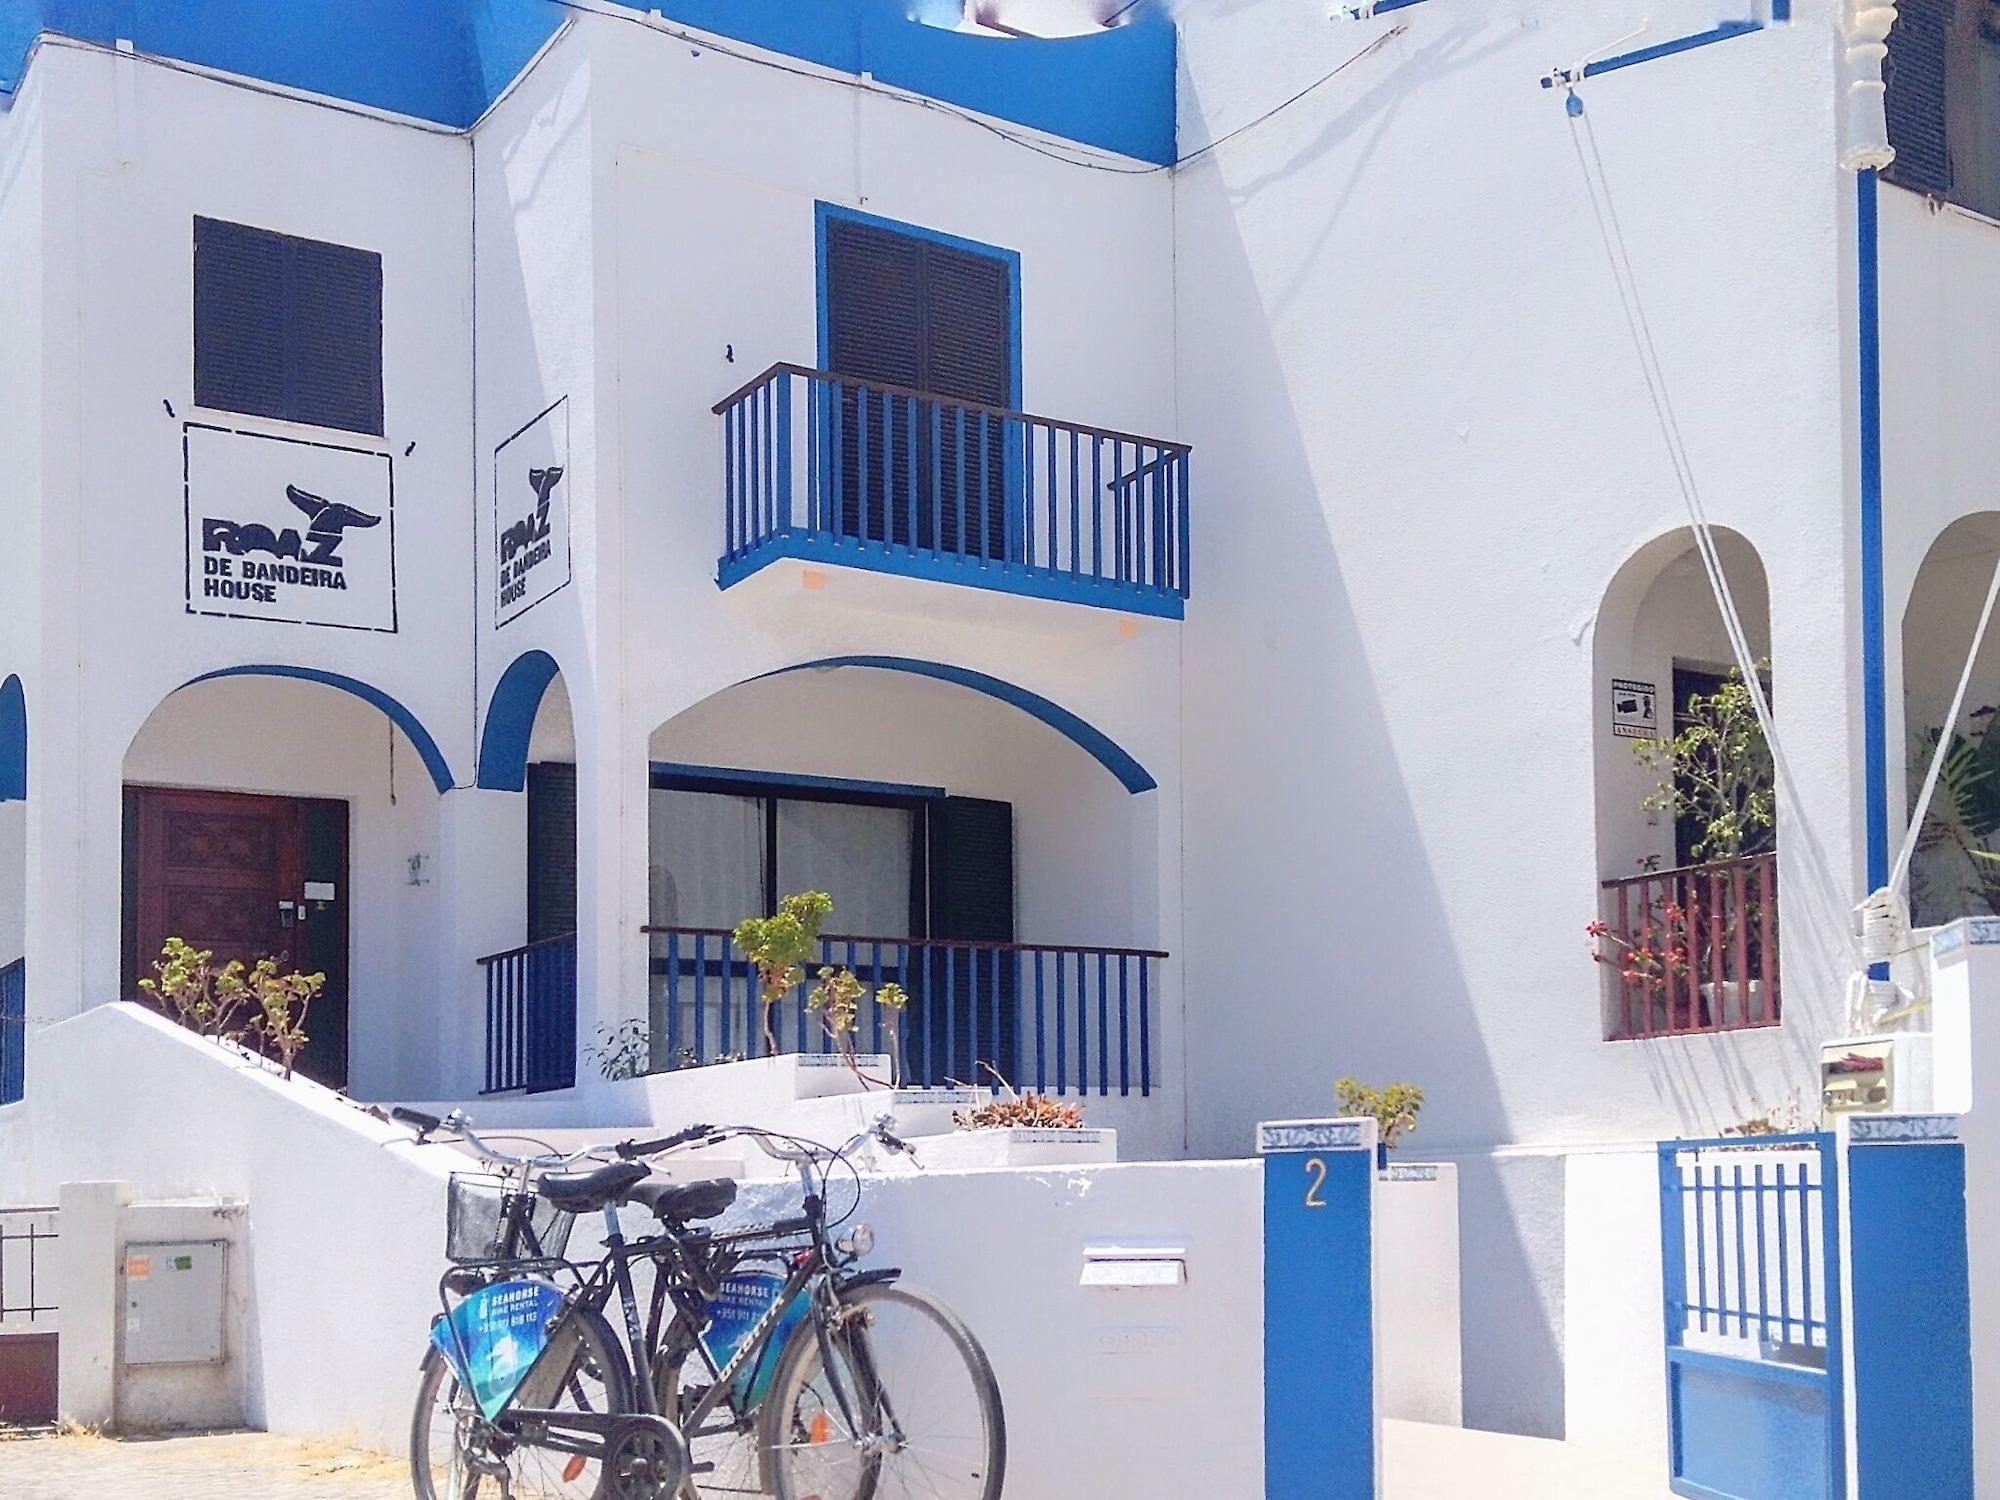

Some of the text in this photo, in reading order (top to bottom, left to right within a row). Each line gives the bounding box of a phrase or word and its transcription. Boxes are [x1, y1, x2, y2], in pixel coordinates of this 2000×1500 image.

[202, 517, 343, 567] ROAZ
[204, 556, 347, 590] DE BANDEIRA
[501, 566, 511, 588] DE
[204, 578, 277, 602] HOUSE
[1305, 1158, 1327, 1207] 2
[492, 1286, 540, 1307] SEAHORSE
[720, 1282, 769, 1298] SEAHORSE
